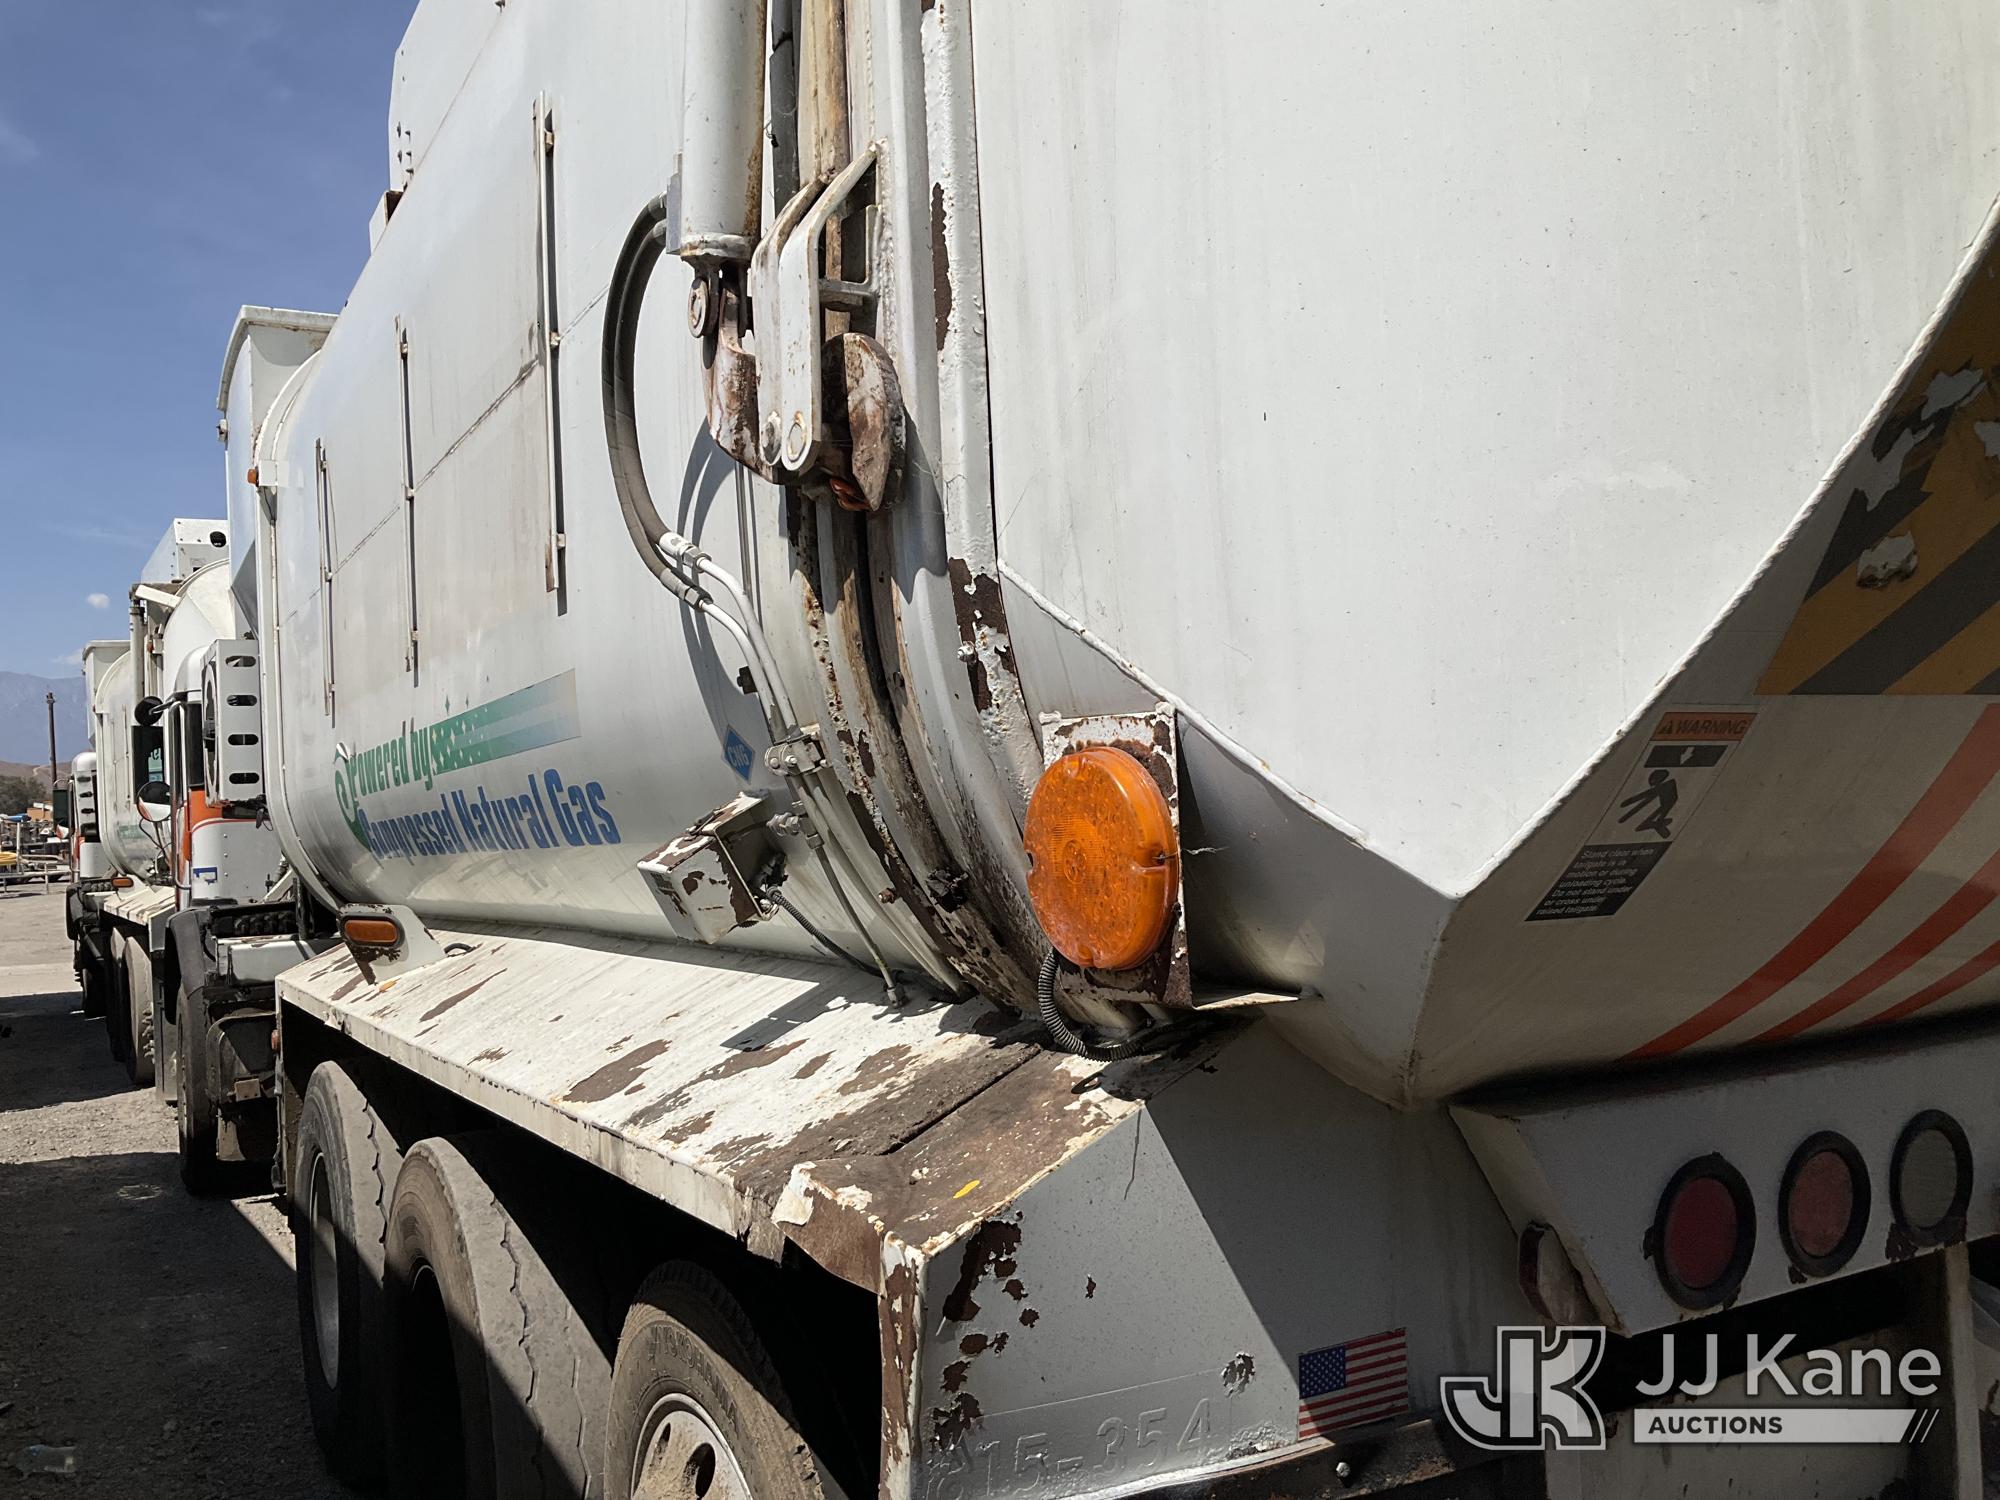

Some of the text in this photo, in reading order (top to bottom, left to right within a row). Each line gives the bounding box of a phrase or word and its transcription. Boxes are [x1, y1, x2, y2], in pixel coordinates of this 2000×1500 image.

[1676, 719, 1748, 735] WARNING
[350, 717, 433, 799] Powered by
[727, 743, 750, 769] CNG
[357, 768, 621, 867] Compressed Natural Gas
